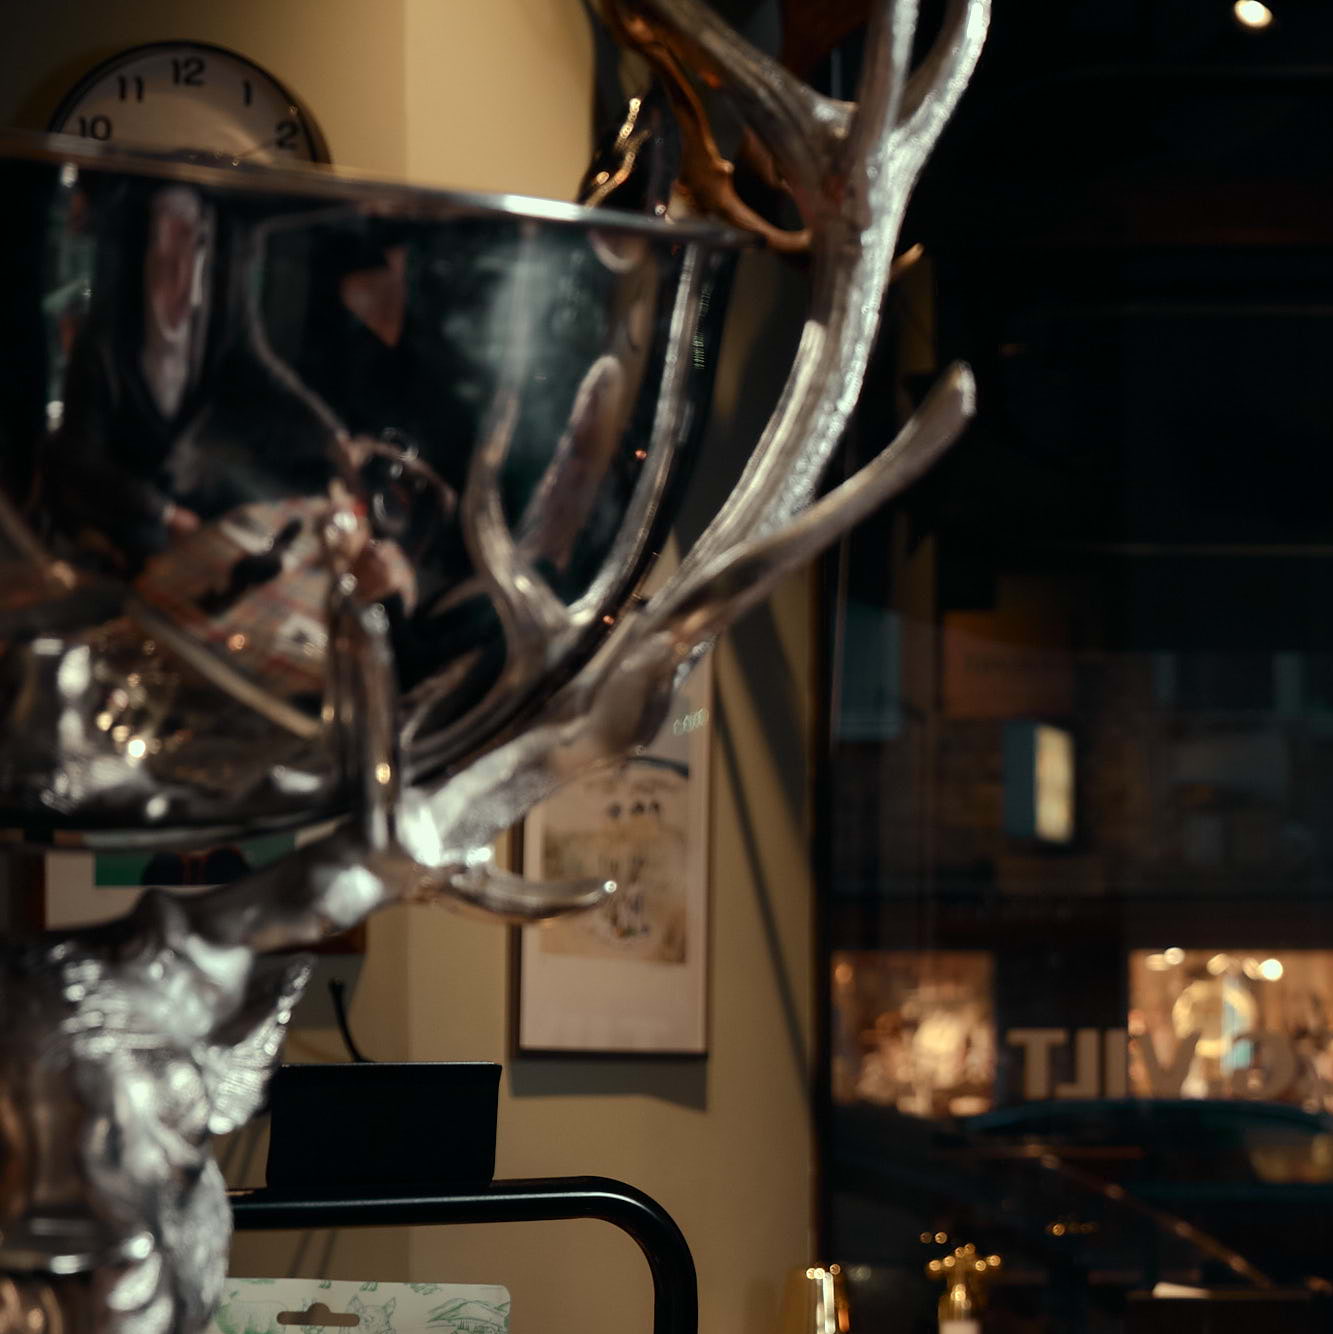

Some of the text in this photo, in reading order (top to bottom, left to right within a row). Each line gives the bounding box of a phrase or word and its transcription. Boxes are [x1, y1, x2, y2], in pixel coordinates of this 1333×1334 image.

[171, 57, 206, 86] 12
[117, 76, 144, 103] 11
[243, 80, 253, 106] 1
[78, 115, 112, 141] 10
[275, 120, 298, 148] 2
